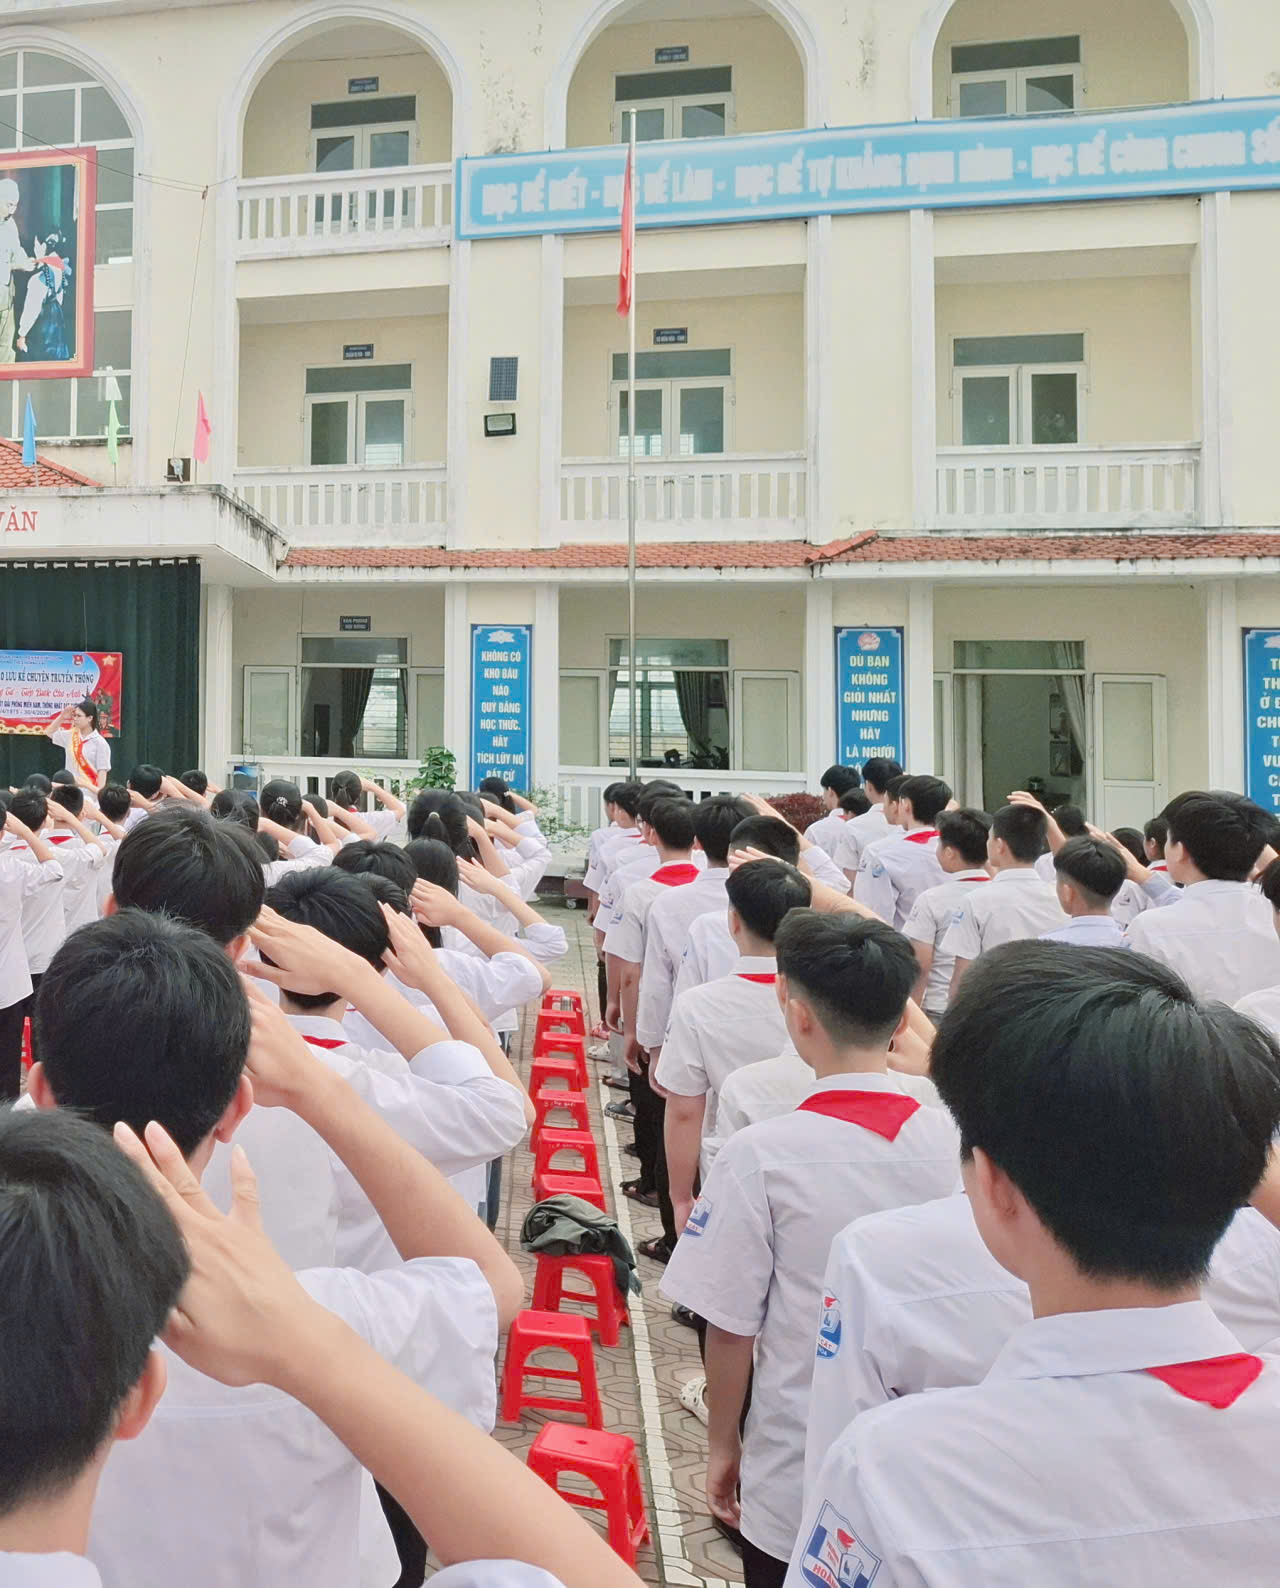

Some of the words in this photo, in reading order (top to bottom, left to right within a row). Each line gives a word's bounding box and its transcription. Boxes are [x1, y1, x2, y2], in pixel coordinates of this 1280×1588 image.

[481, 650, 508, 662] KHÔNG
[867, 655, 889, 669] BẠN
[484, 668, 500, 679] KHO
[851, 671, 888, 685] KHÔNG
[868, 688, 896, 704] NHẤT
[851, 709, 889, 722] NHƯNG
[480, 719, 496, 731] HỌC
[846, 744, 859, 757] LÀ
[477, 751, 494, 764] TÍCH
